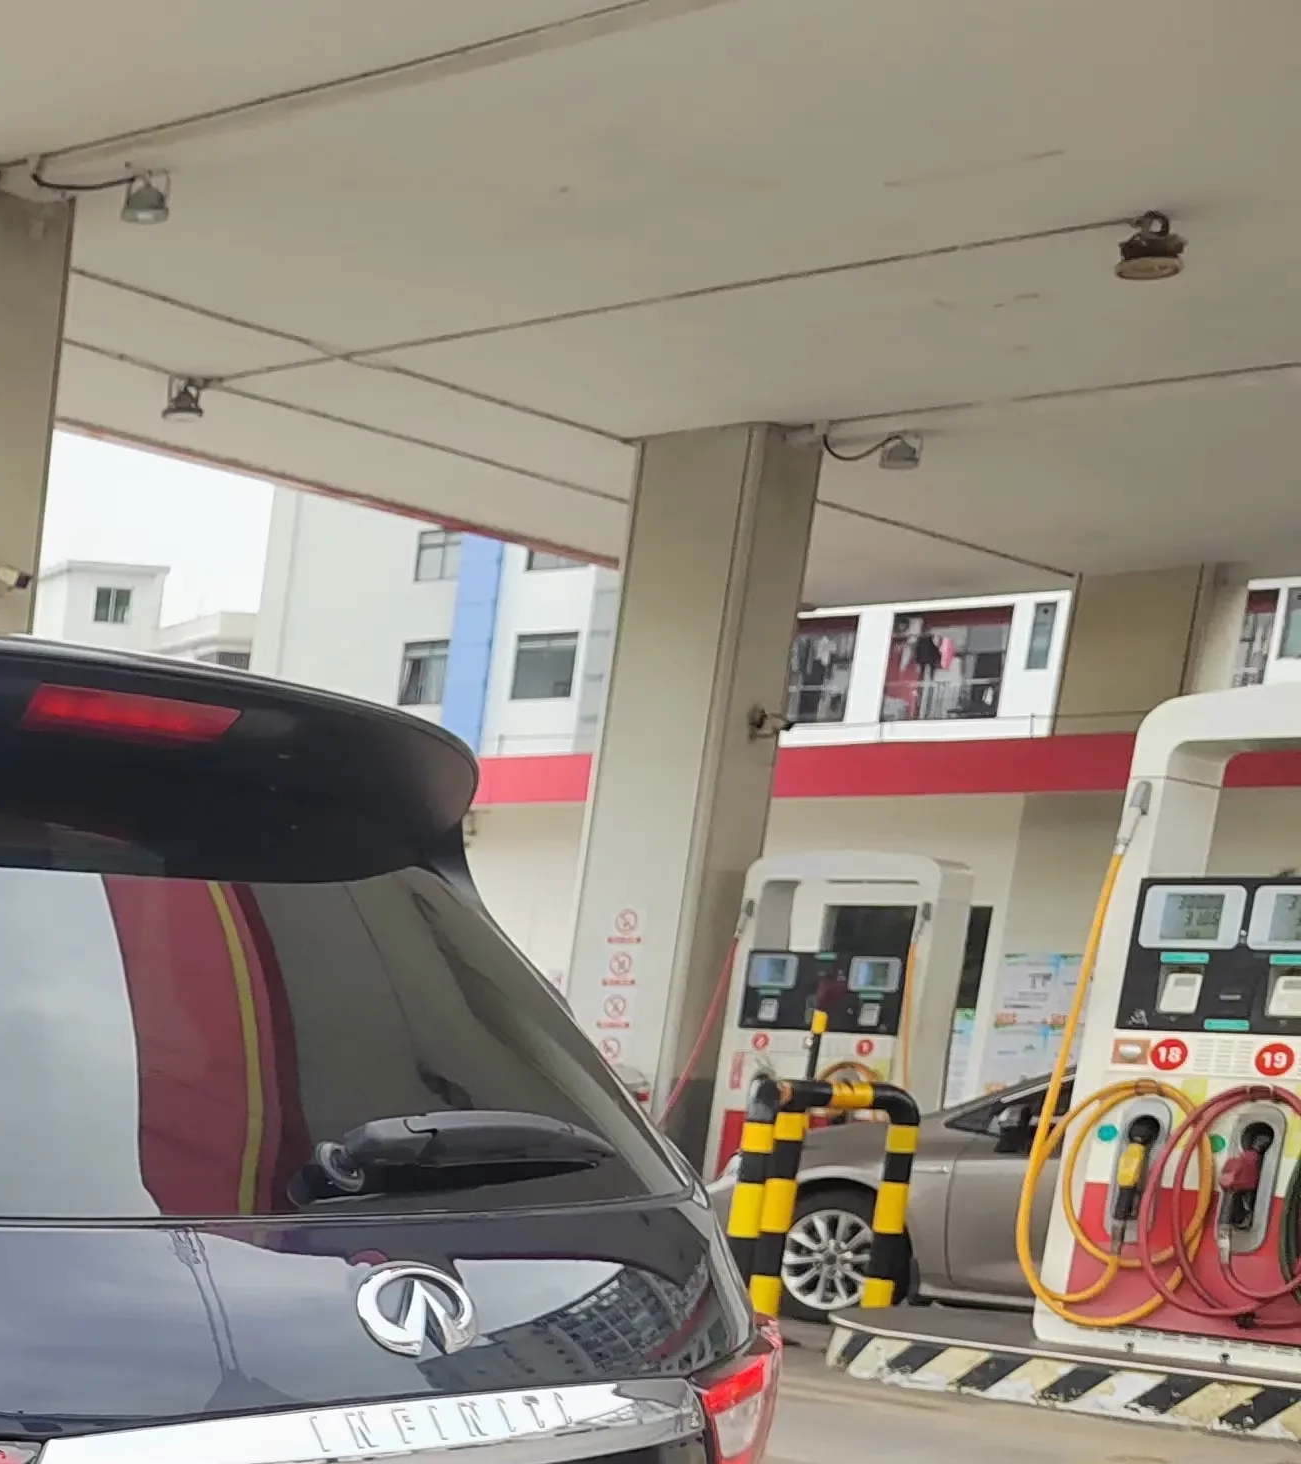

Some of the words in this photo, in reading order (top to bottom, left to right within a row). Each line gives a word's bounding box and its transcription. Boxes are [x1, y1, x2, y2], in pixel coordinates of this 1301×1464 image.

[1156, 1045, 1183, 1064] 18
[1261, 1051, 1288, 1069] 19
[308, 1392, 573, 1452] INFINITI
